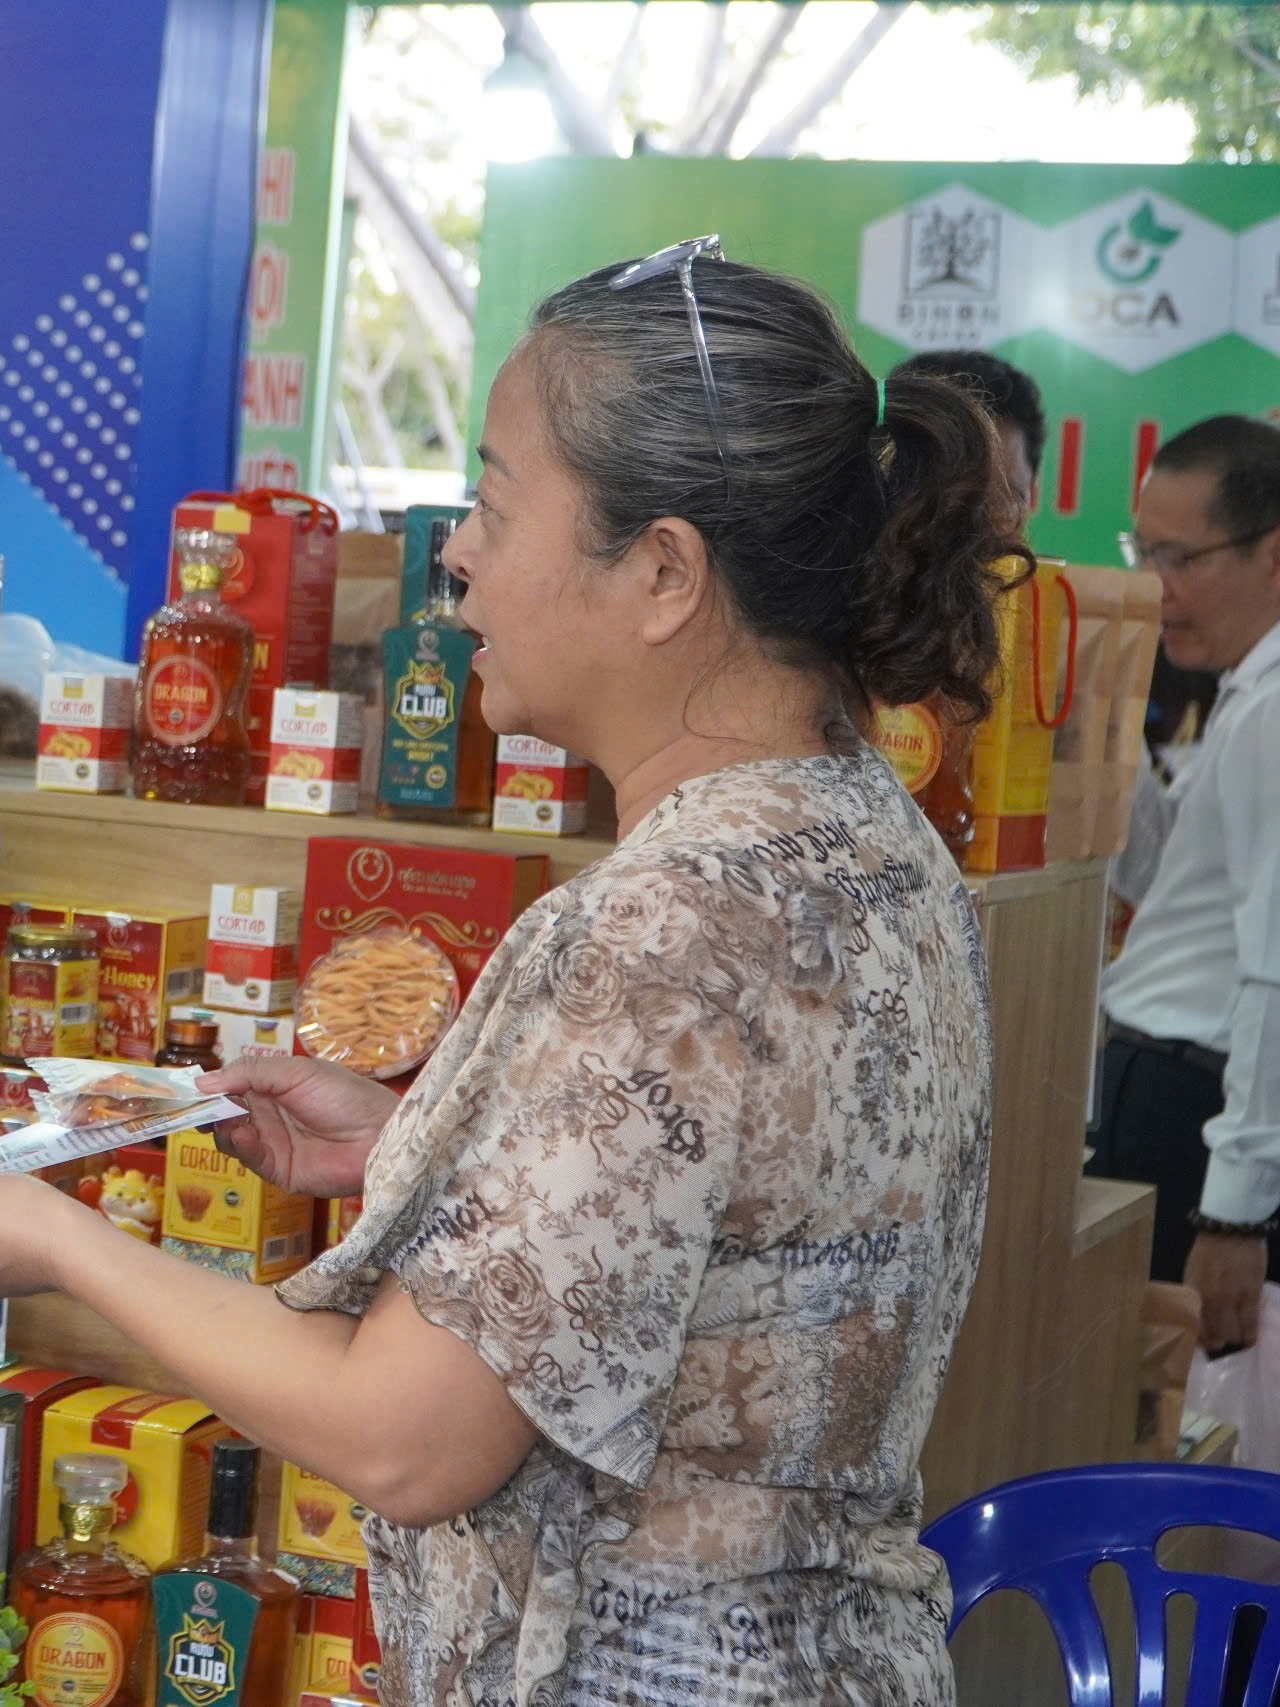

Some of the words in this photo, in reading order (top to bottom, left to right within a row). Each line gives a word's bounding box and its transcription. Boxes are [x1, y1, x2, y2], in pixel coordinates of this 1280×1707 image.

[154, 683, 208, 704] DRAGON
[399, 694, 448, 718] CLUB
[39, 1646, 106, 1669] DRAGON
[174, 1653, 228, 1686] CLUB
